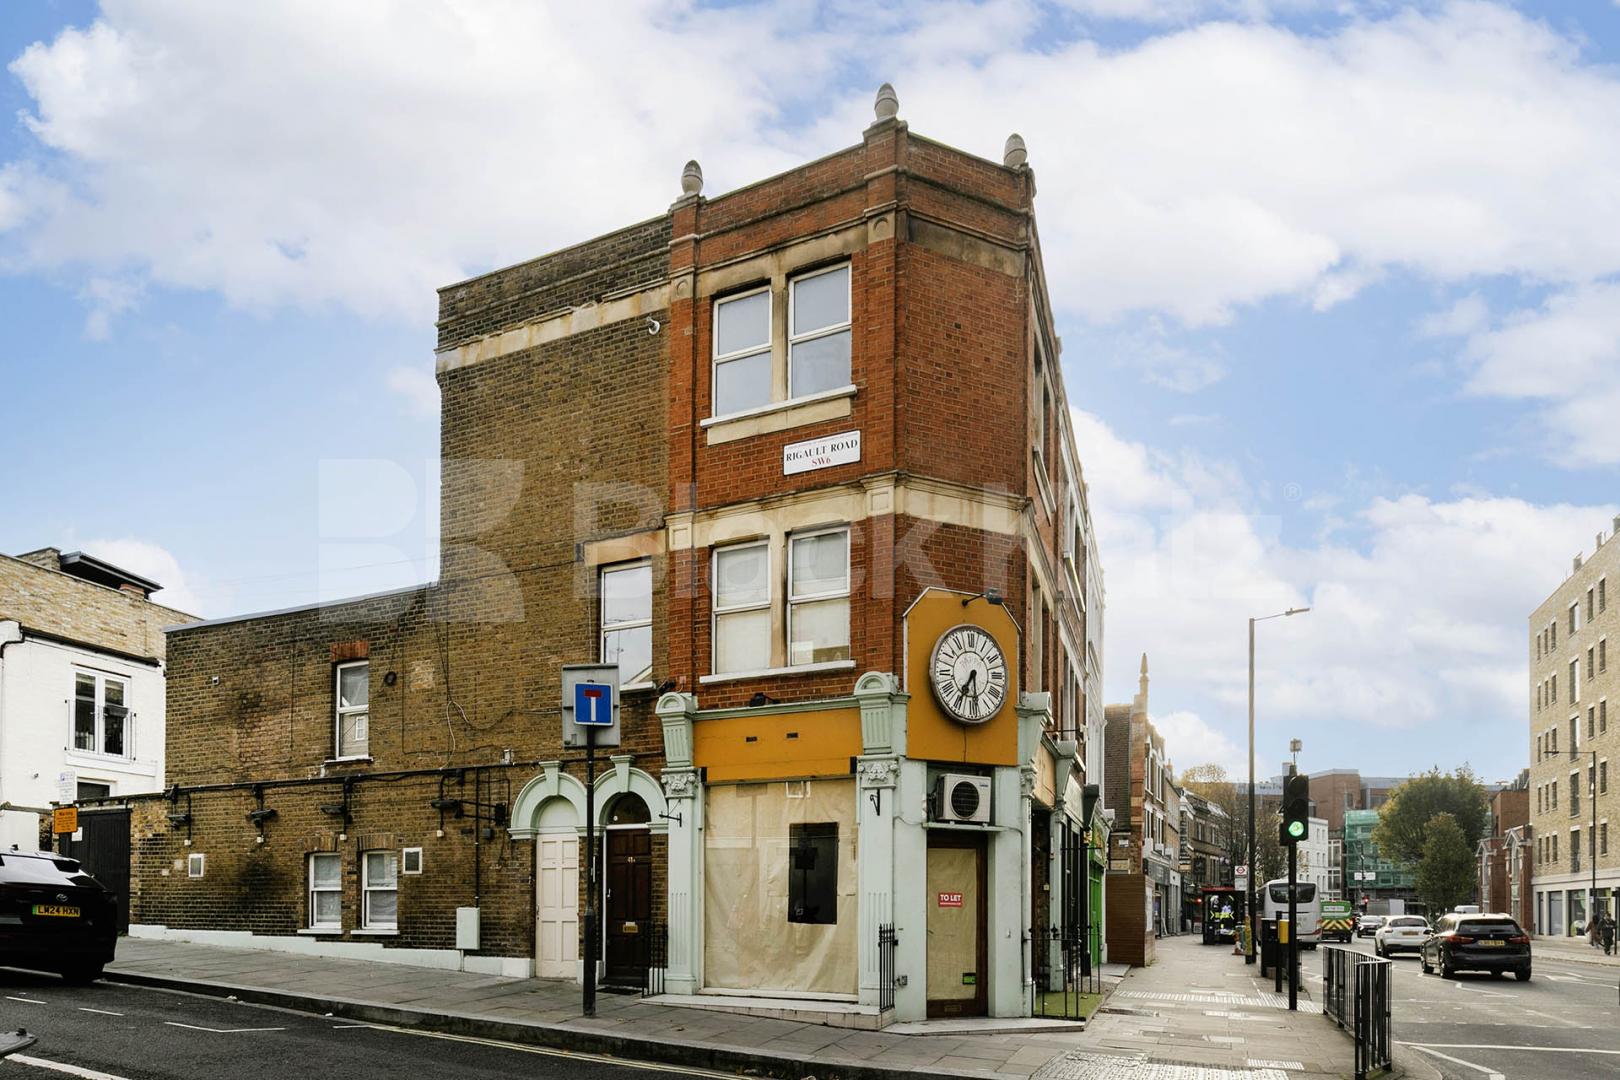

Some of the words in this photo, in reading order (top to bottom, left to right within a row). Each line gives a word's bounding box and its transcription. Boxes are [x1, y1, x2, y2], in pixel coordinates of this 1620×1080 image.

[786, 446, 826, 461] RIGAULT
[830, 440, 857, 452] ROAD
[811, 457, 831, 466] SW6
